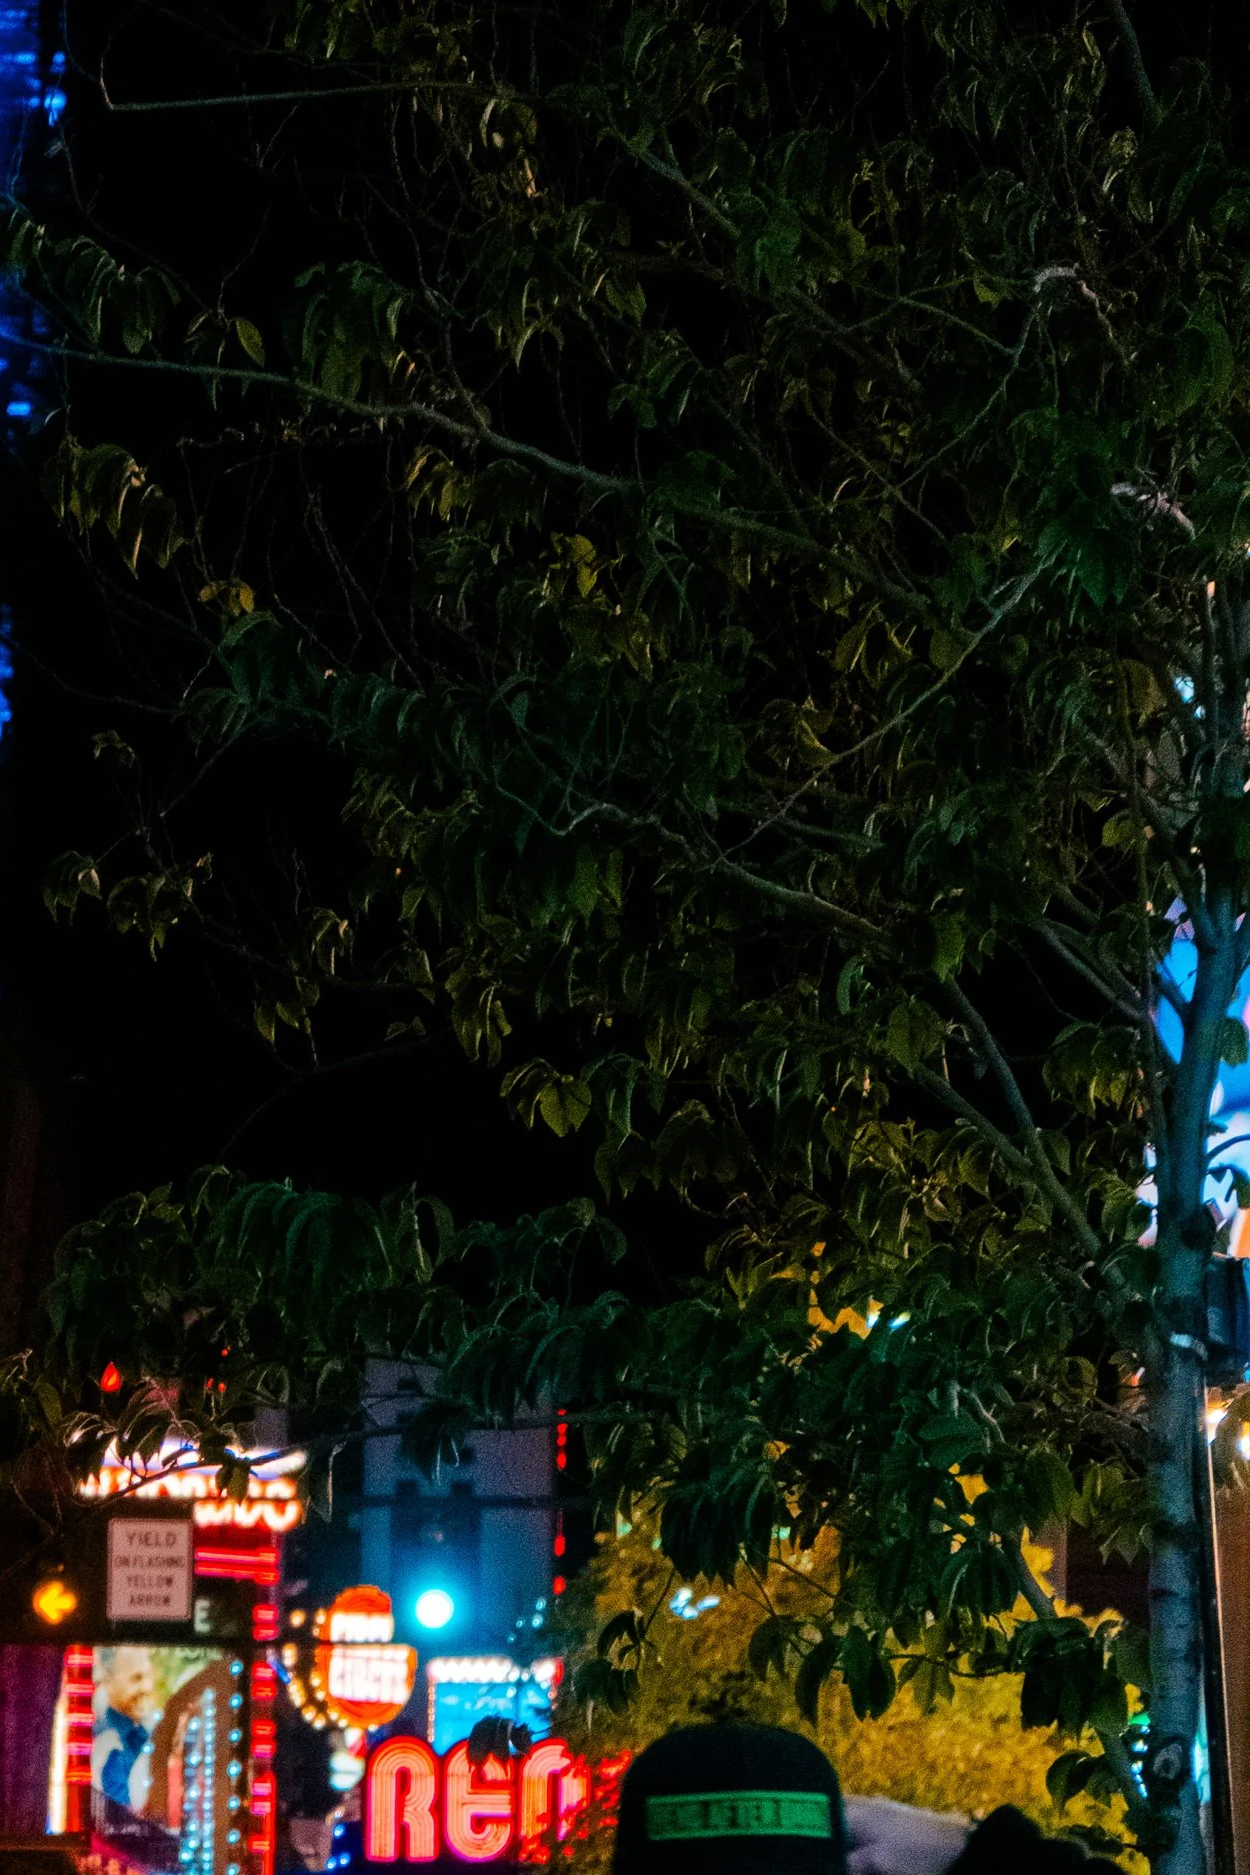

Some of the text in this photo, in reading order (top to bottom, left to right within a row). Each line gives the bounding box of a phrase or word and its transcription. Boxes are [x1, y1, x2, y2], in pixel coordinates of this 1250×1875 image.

[126, 1531, 177, 1548] YIELD
[126, 1574, 173, 1589] YELLOW
[128, 1594, 171, 1607] ARROW
